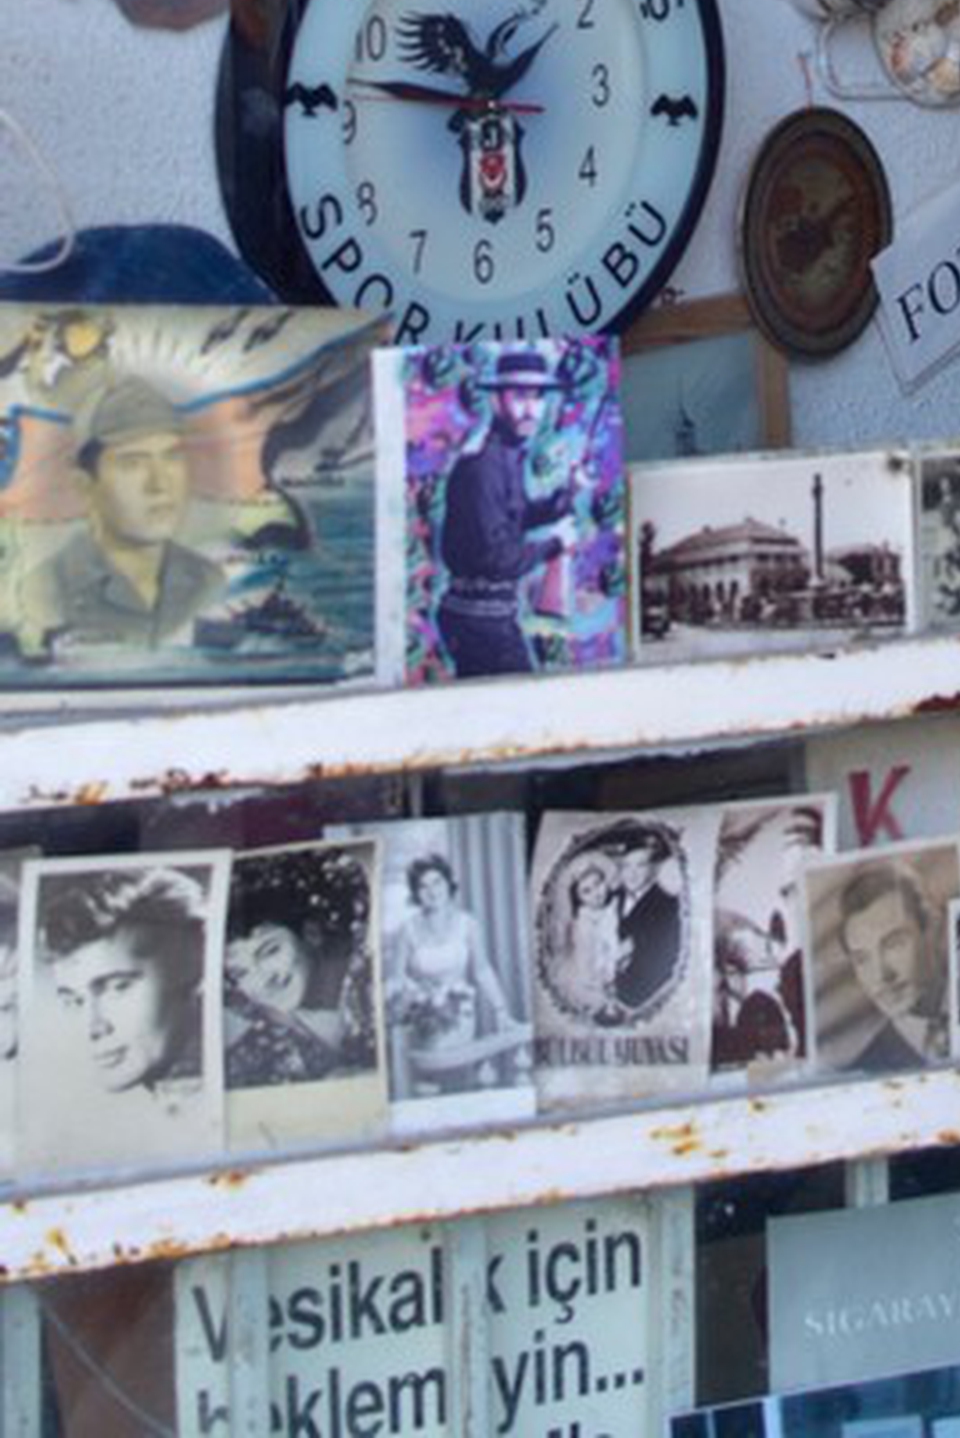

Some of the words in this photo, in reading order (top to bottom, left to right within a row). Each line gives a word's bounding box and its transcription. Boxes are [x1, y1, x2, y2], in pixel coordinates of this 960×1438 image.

[591, 63, 611, 107] 3
[578, 147, 598, 187] 4
[357, 182, 377, 227] 8
[409, 229, 428, 274] 7
[536, 209, 556, 253] 5
[473, 238, 495, 285] 6
[193, 1246, 505, 1362] Vsikalk
[529, 1221, 640, 1324] için
[196, 1329, 646, 1438] bklemyin...
